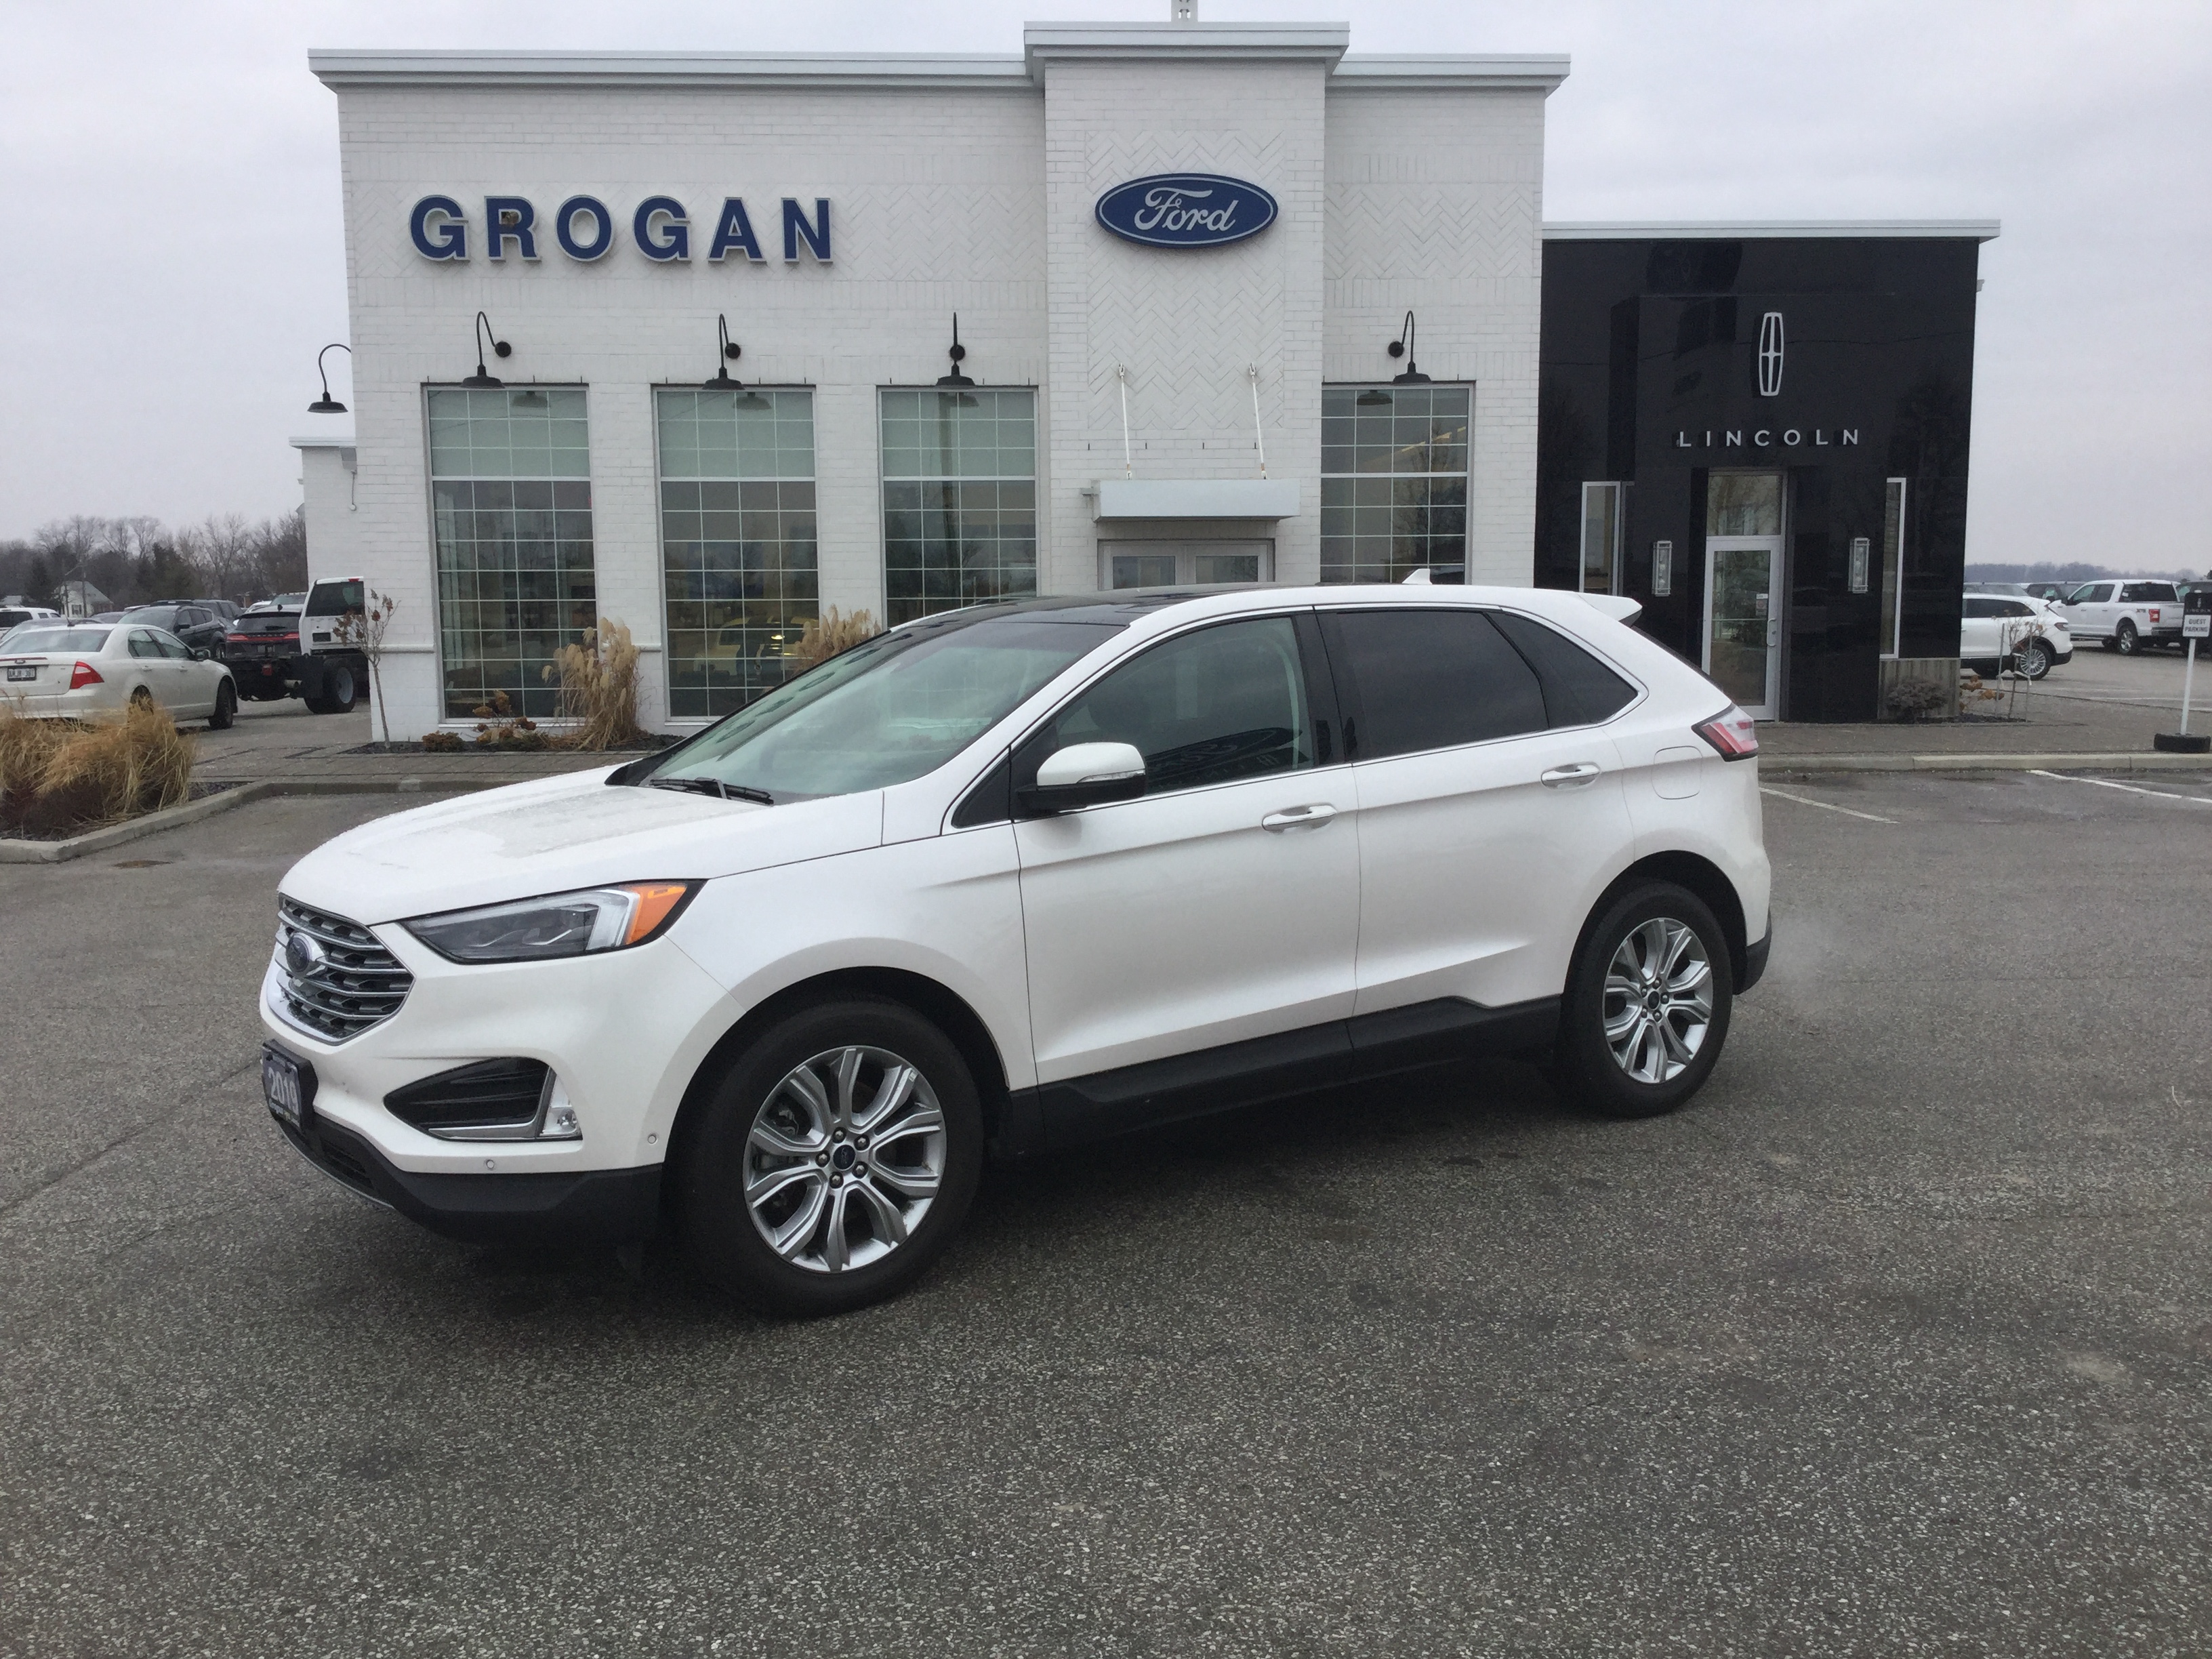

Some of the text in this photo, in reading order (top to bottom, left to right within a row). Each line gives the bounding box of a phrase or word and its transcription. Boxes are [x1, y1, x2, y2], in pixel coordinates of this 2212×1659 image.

[409, 195, 834, 263] GROGAN
[1134, 187, 1239, 231] Ford
[1678, 429, 1858, 447] LINCOLN
[268, 1066, 299, 1115] 2019
